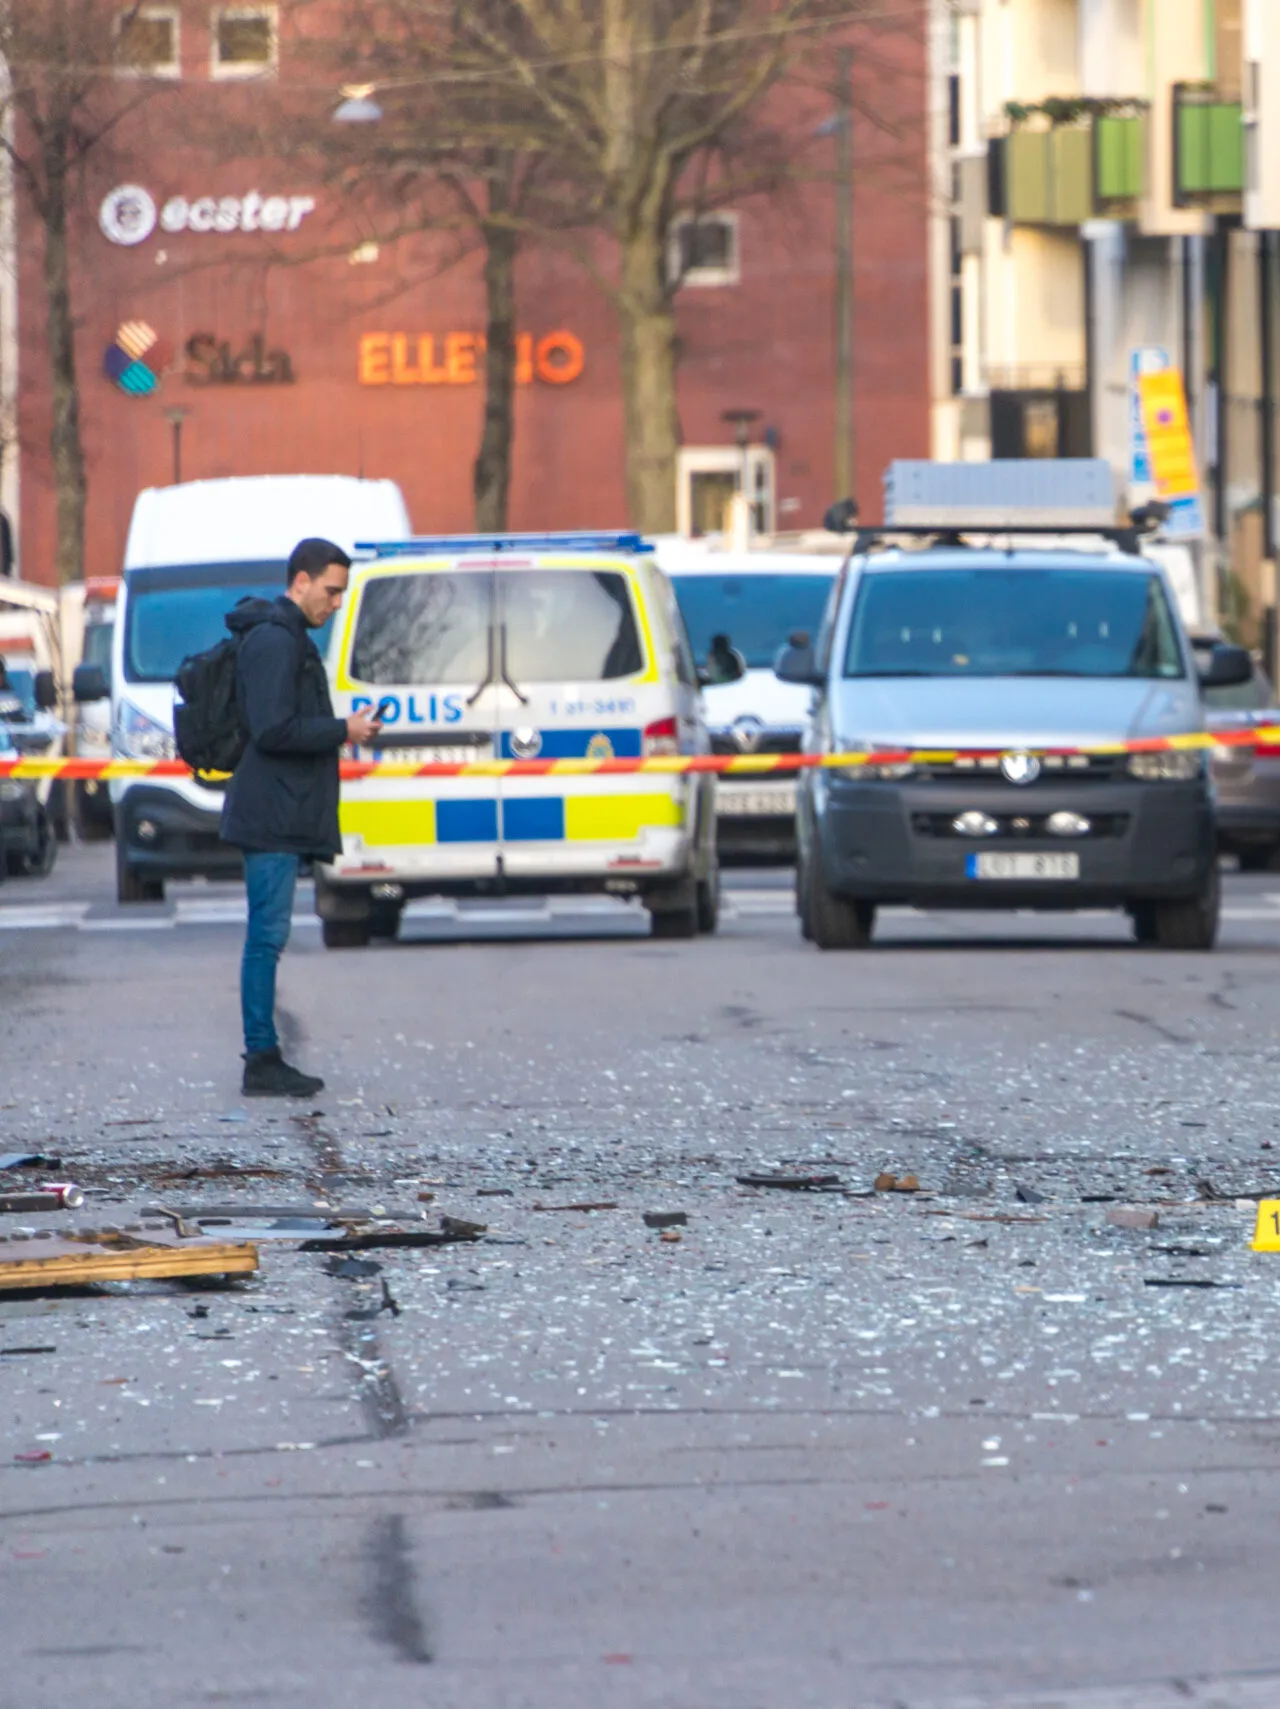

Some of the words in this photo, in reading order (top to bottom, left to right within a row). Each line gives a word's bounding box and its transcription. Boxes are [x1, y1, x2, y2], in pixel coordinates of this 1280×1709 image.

[160, 190, 316, 233] ecster
[357, 329, 584, 385] ELLEIO
[1270, 1211, 1280, 1236] 1
